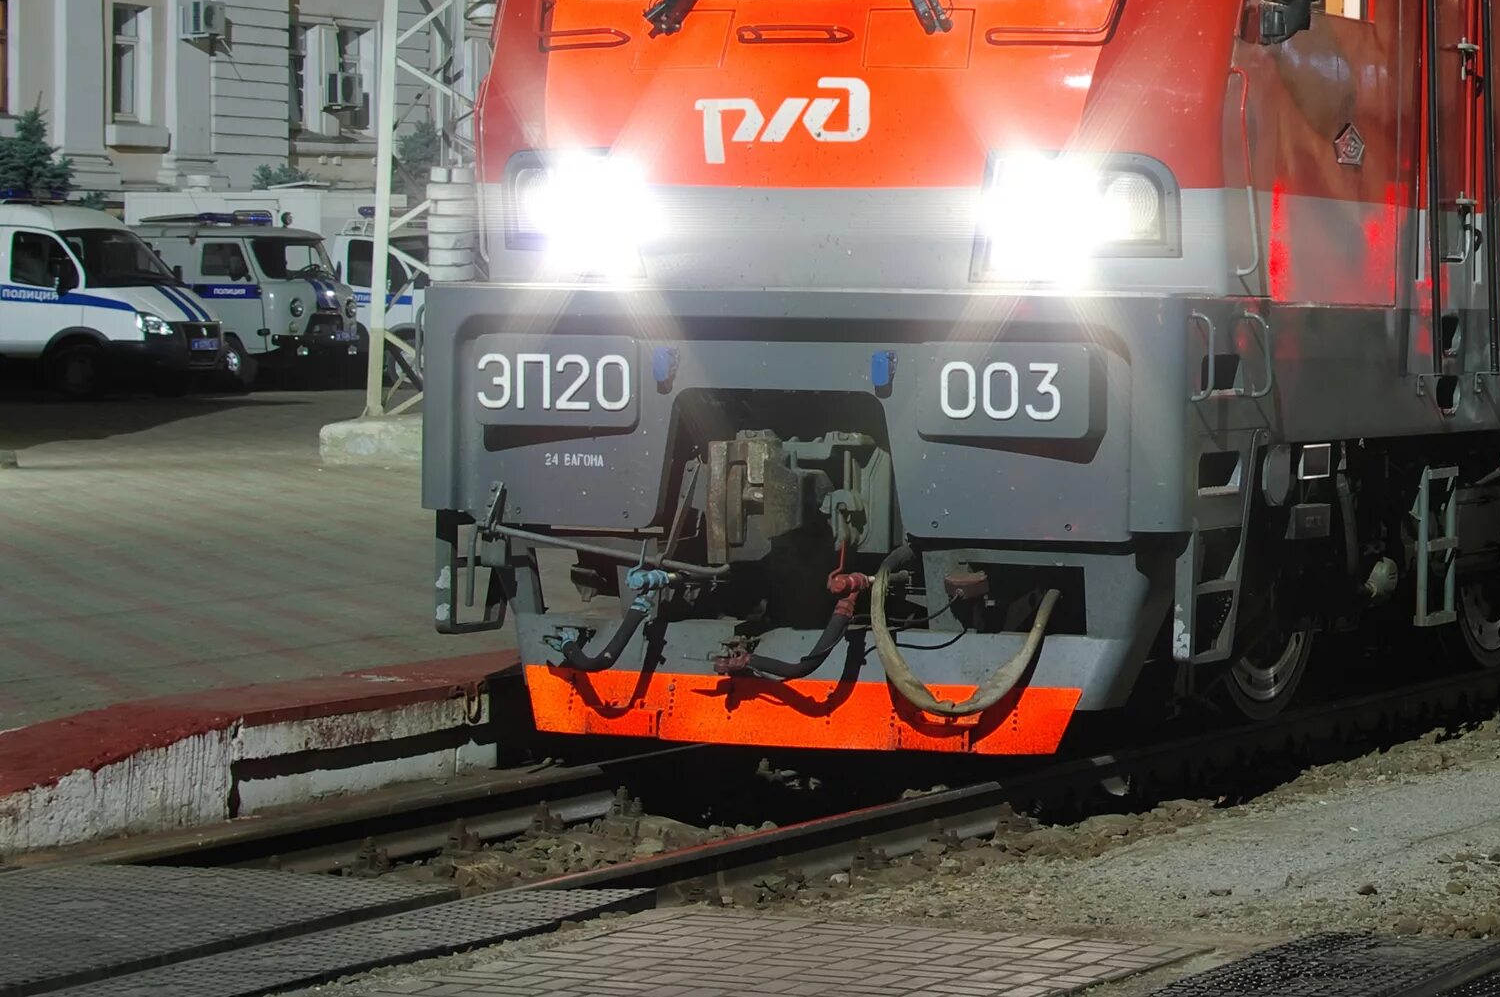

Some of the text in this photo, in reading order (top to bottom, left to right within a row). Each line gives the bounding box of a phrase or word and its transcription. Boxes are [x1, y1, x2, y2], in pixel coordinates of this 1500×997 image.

[477, 353, 630, 410] ЭП20
[940, 361, 1061, 420] 003
[544, 452, 604, 467] 24 ВАГОНА
